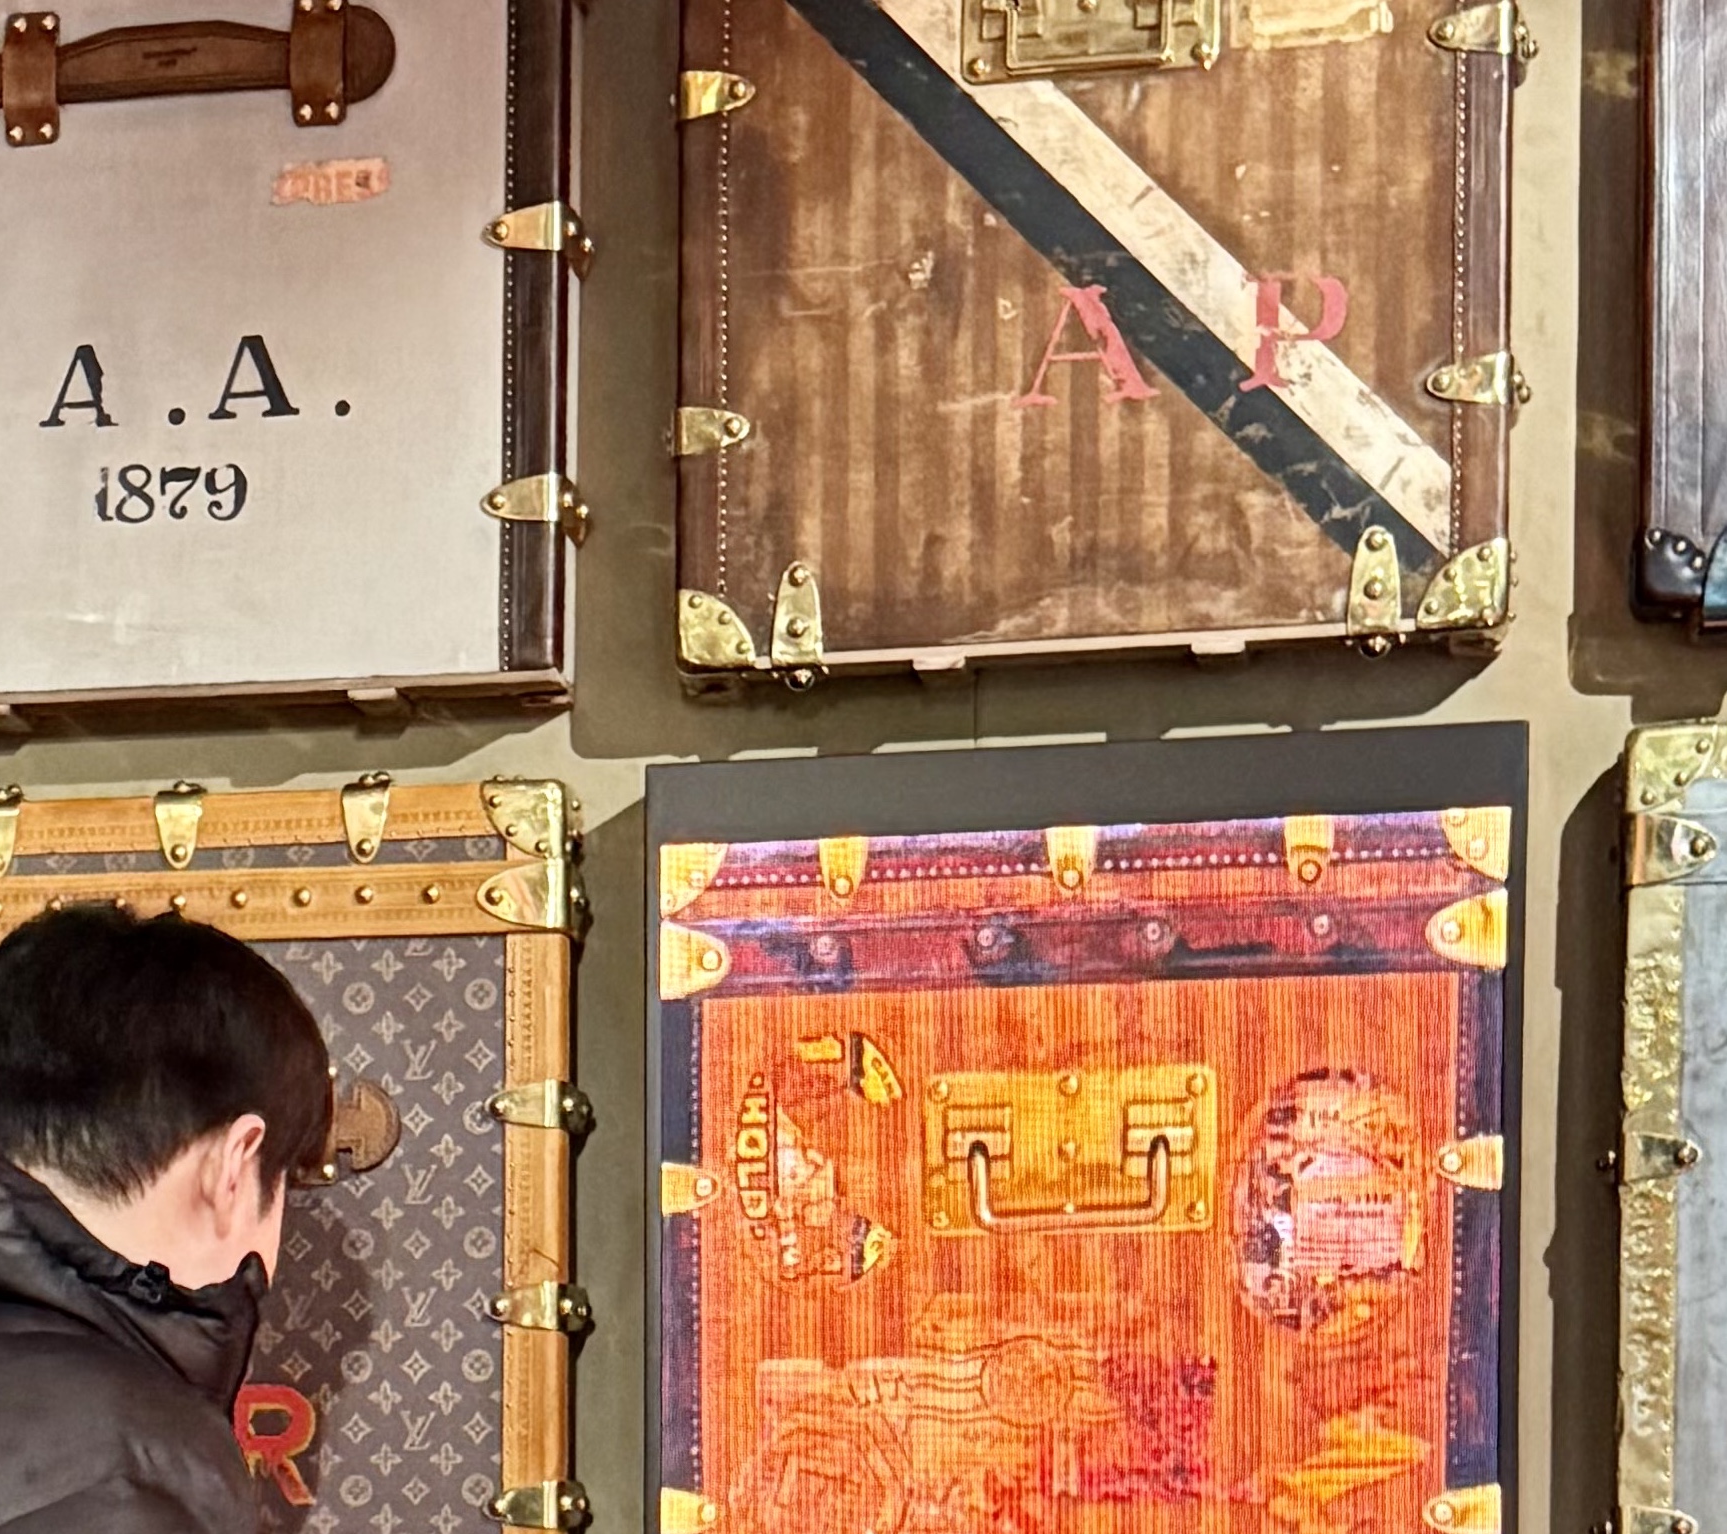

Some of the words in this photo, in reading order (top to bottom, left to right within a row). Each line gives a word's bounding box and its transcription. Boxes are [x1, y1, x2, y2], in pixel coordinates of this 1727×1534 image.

[1011, 284, 1162, 406] A
[1239, 276, 1349, 394] P
[94, 463, 248, 523] 1879
